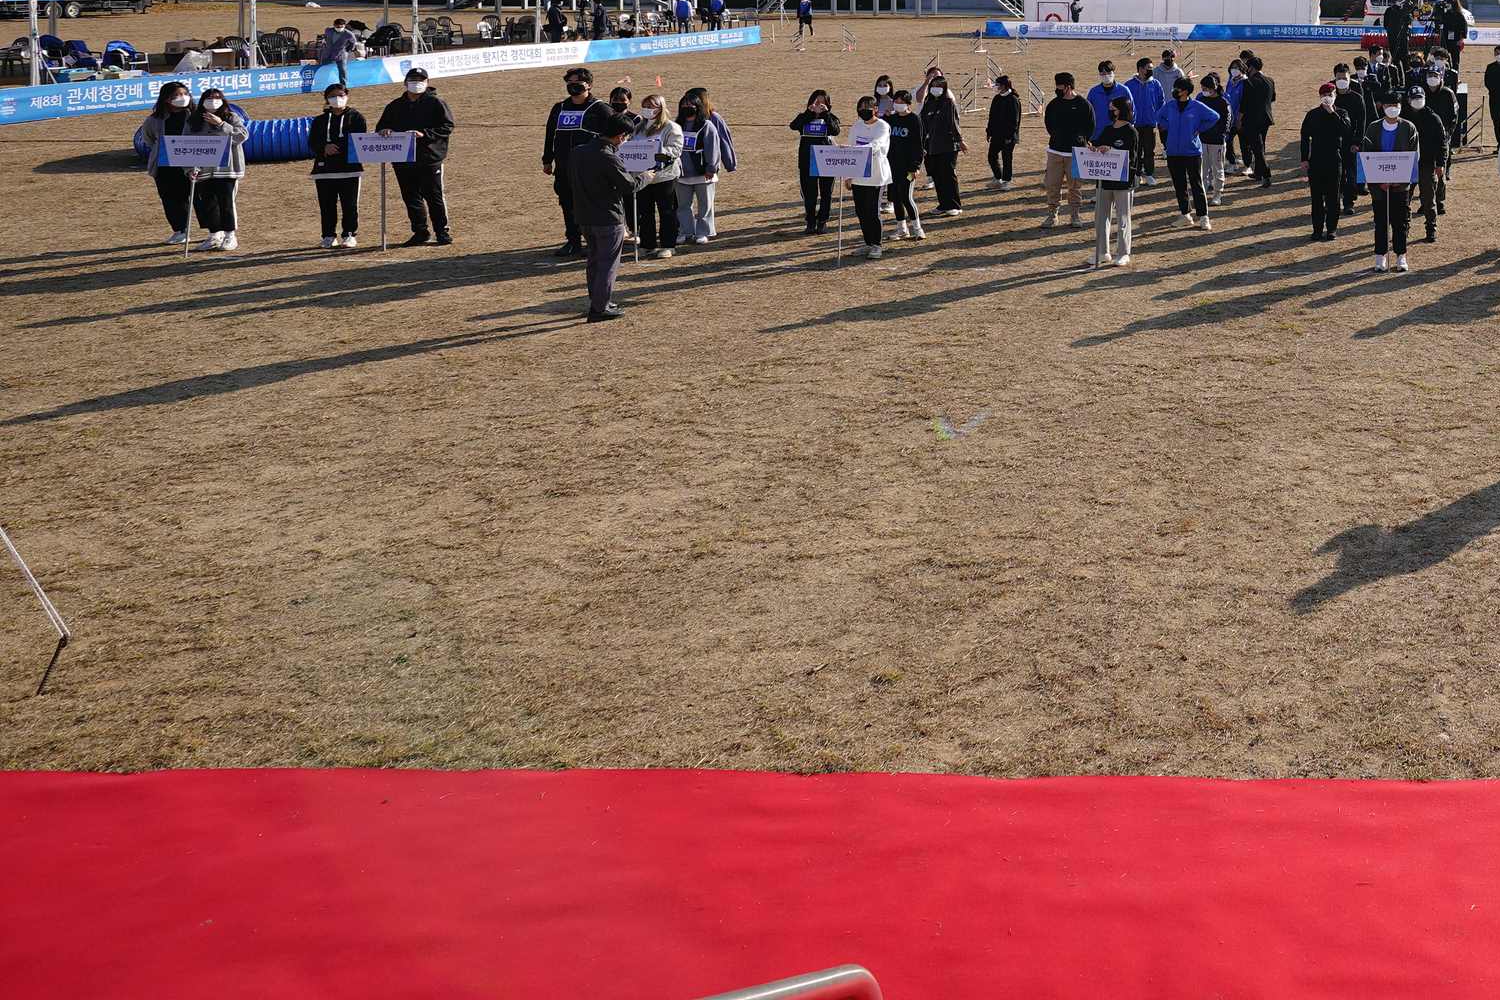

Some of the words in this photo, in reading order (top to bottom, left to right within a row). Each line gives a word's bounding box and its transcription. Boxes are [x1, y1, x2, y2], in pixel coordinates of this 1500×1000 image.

[482, 49, 508, 64] 탐지견
[510, 47, 542, 61] 경진대회
[258, 72, 277, 82] 2021.
[30, 94, 62, 109] 제8회
[66, 81, 143, 105] 관세청장배
[197, 73, 252, 92] 경진대회
[562, 116, 577, 125] 02
[1083, 160, 1118, 169] 서울호서직업
[1378, 164, 1397, 172] 기관부
[1087, 168, 1112, 177] 전문학교
